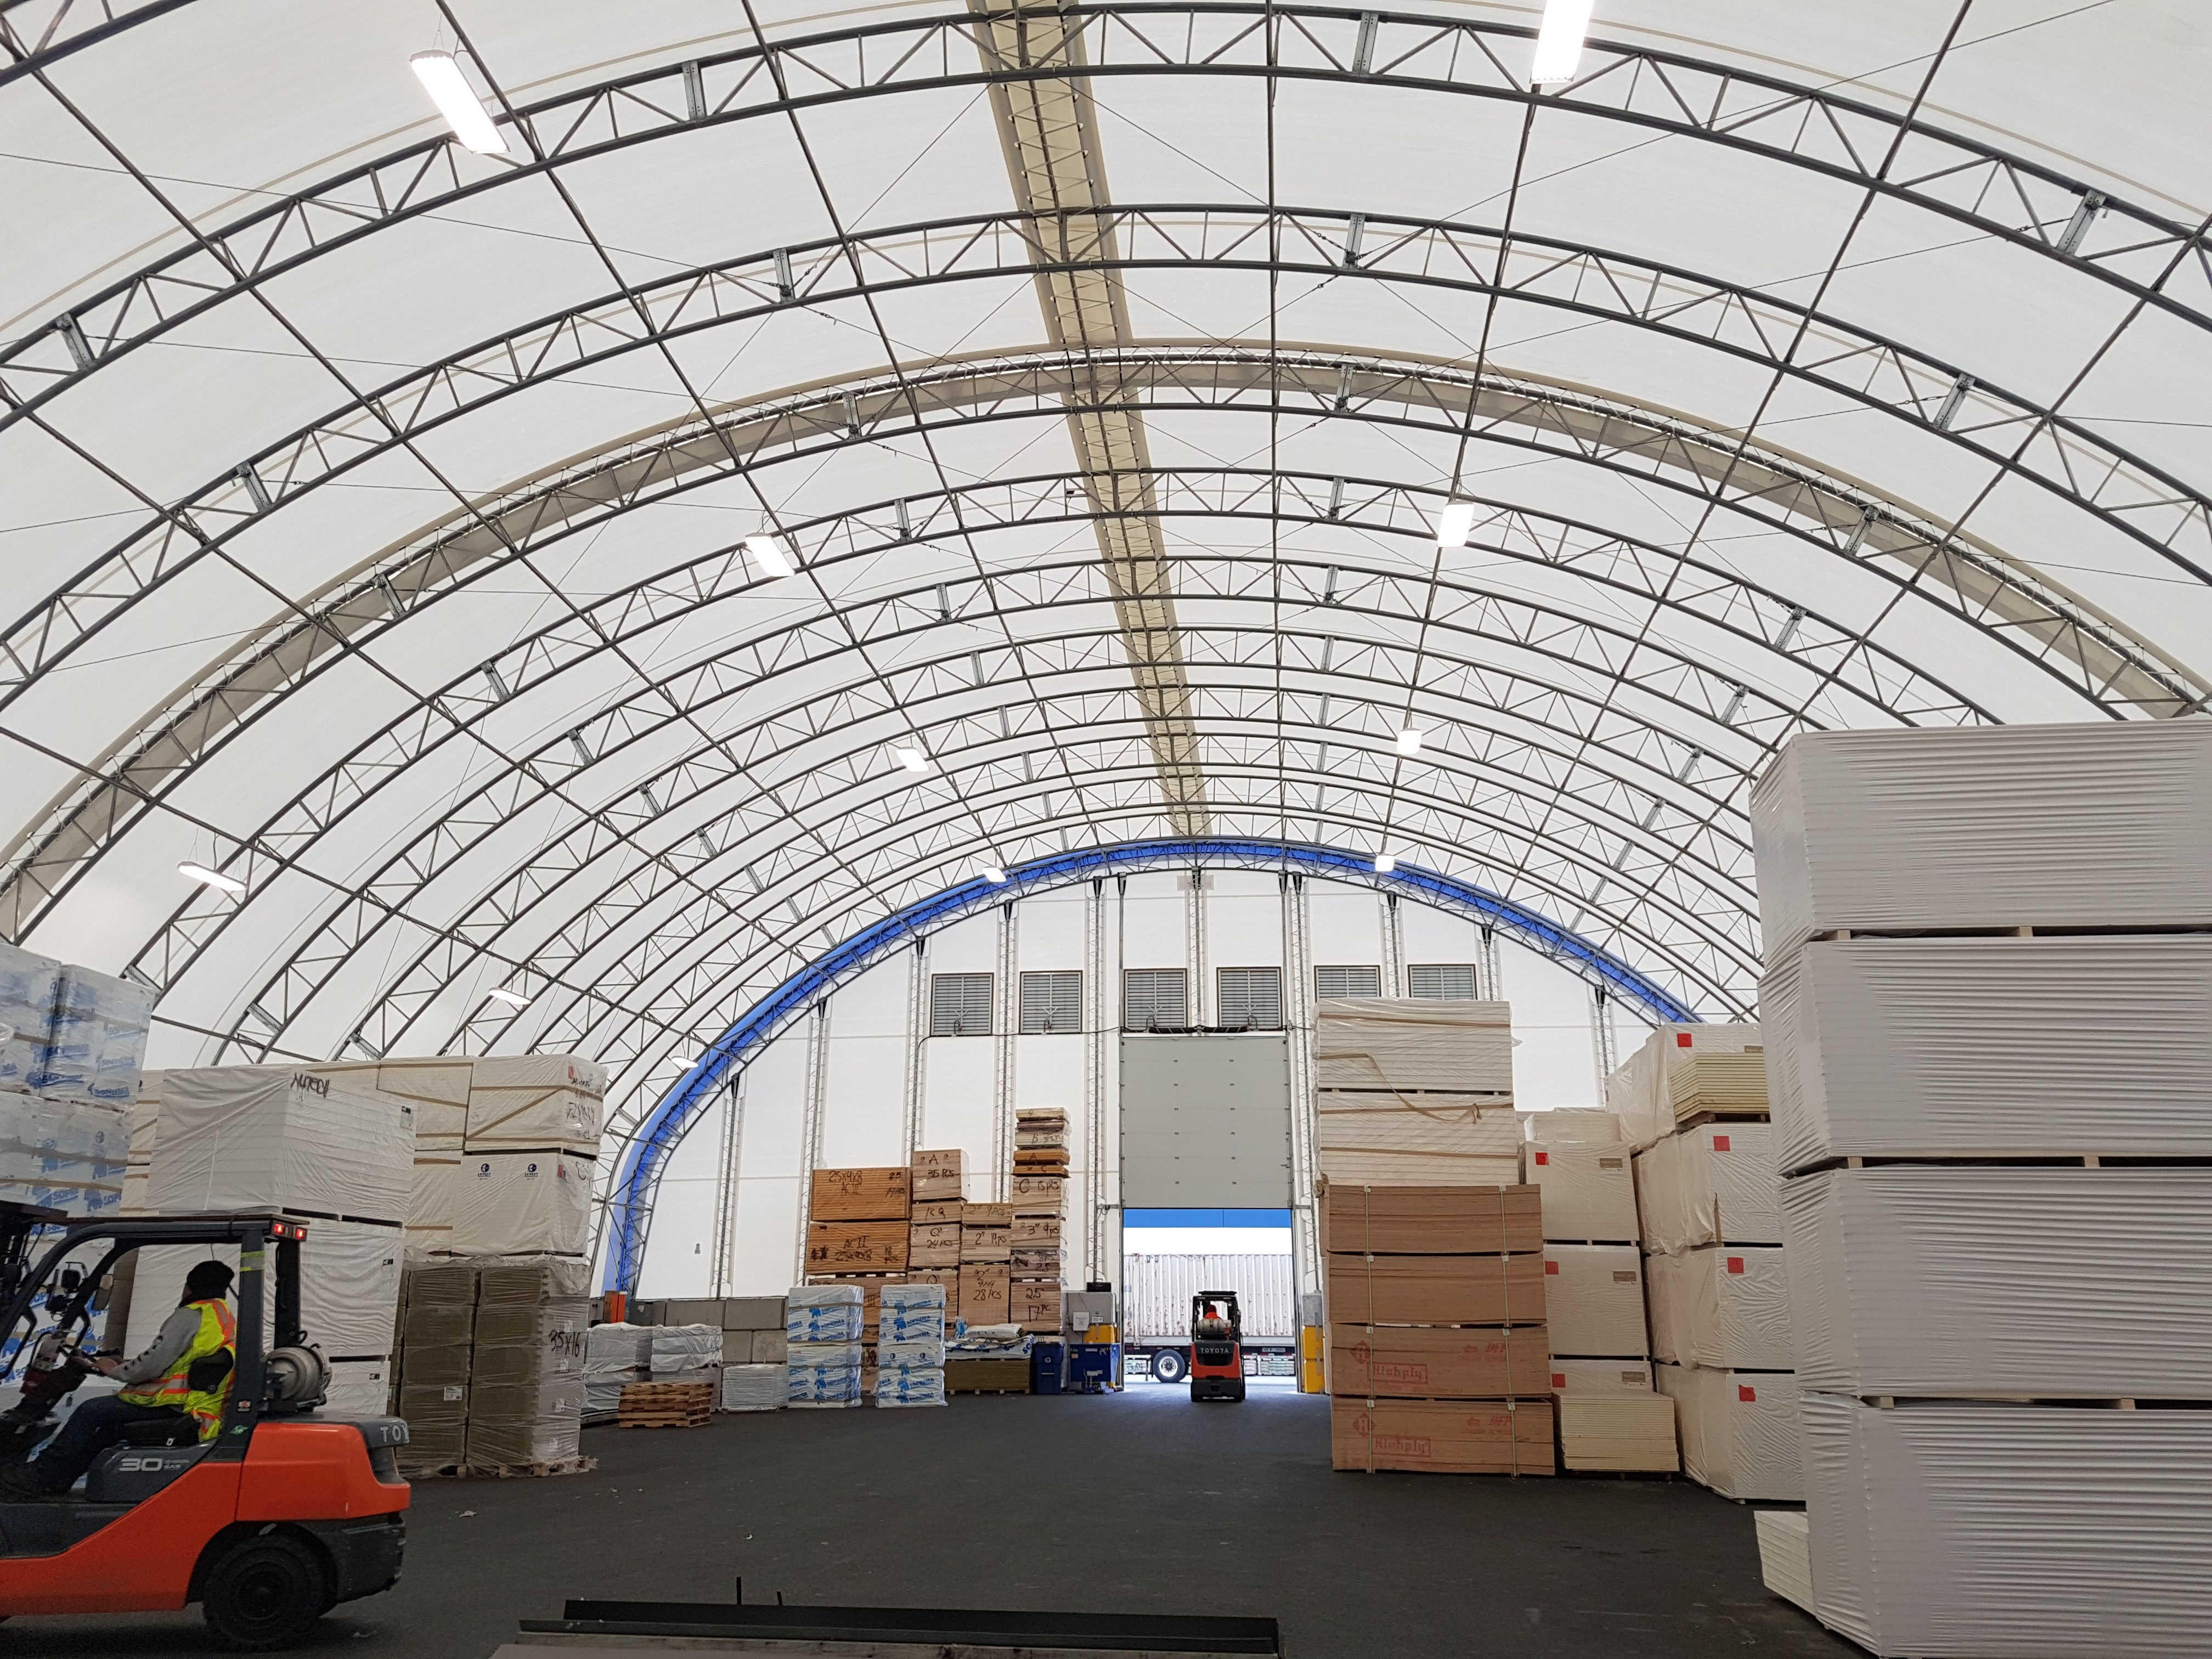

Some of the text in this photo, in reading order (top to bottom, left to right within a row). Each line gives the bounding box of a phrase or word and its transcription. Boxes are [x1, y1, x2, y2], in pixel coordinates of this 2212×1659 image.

[929, 1154, 938, 1165] A
[1019, 1178, 1030, 1193] C
[973, 1289, 986, 1301] 28
[119, 1458, 162, 1471] 30
